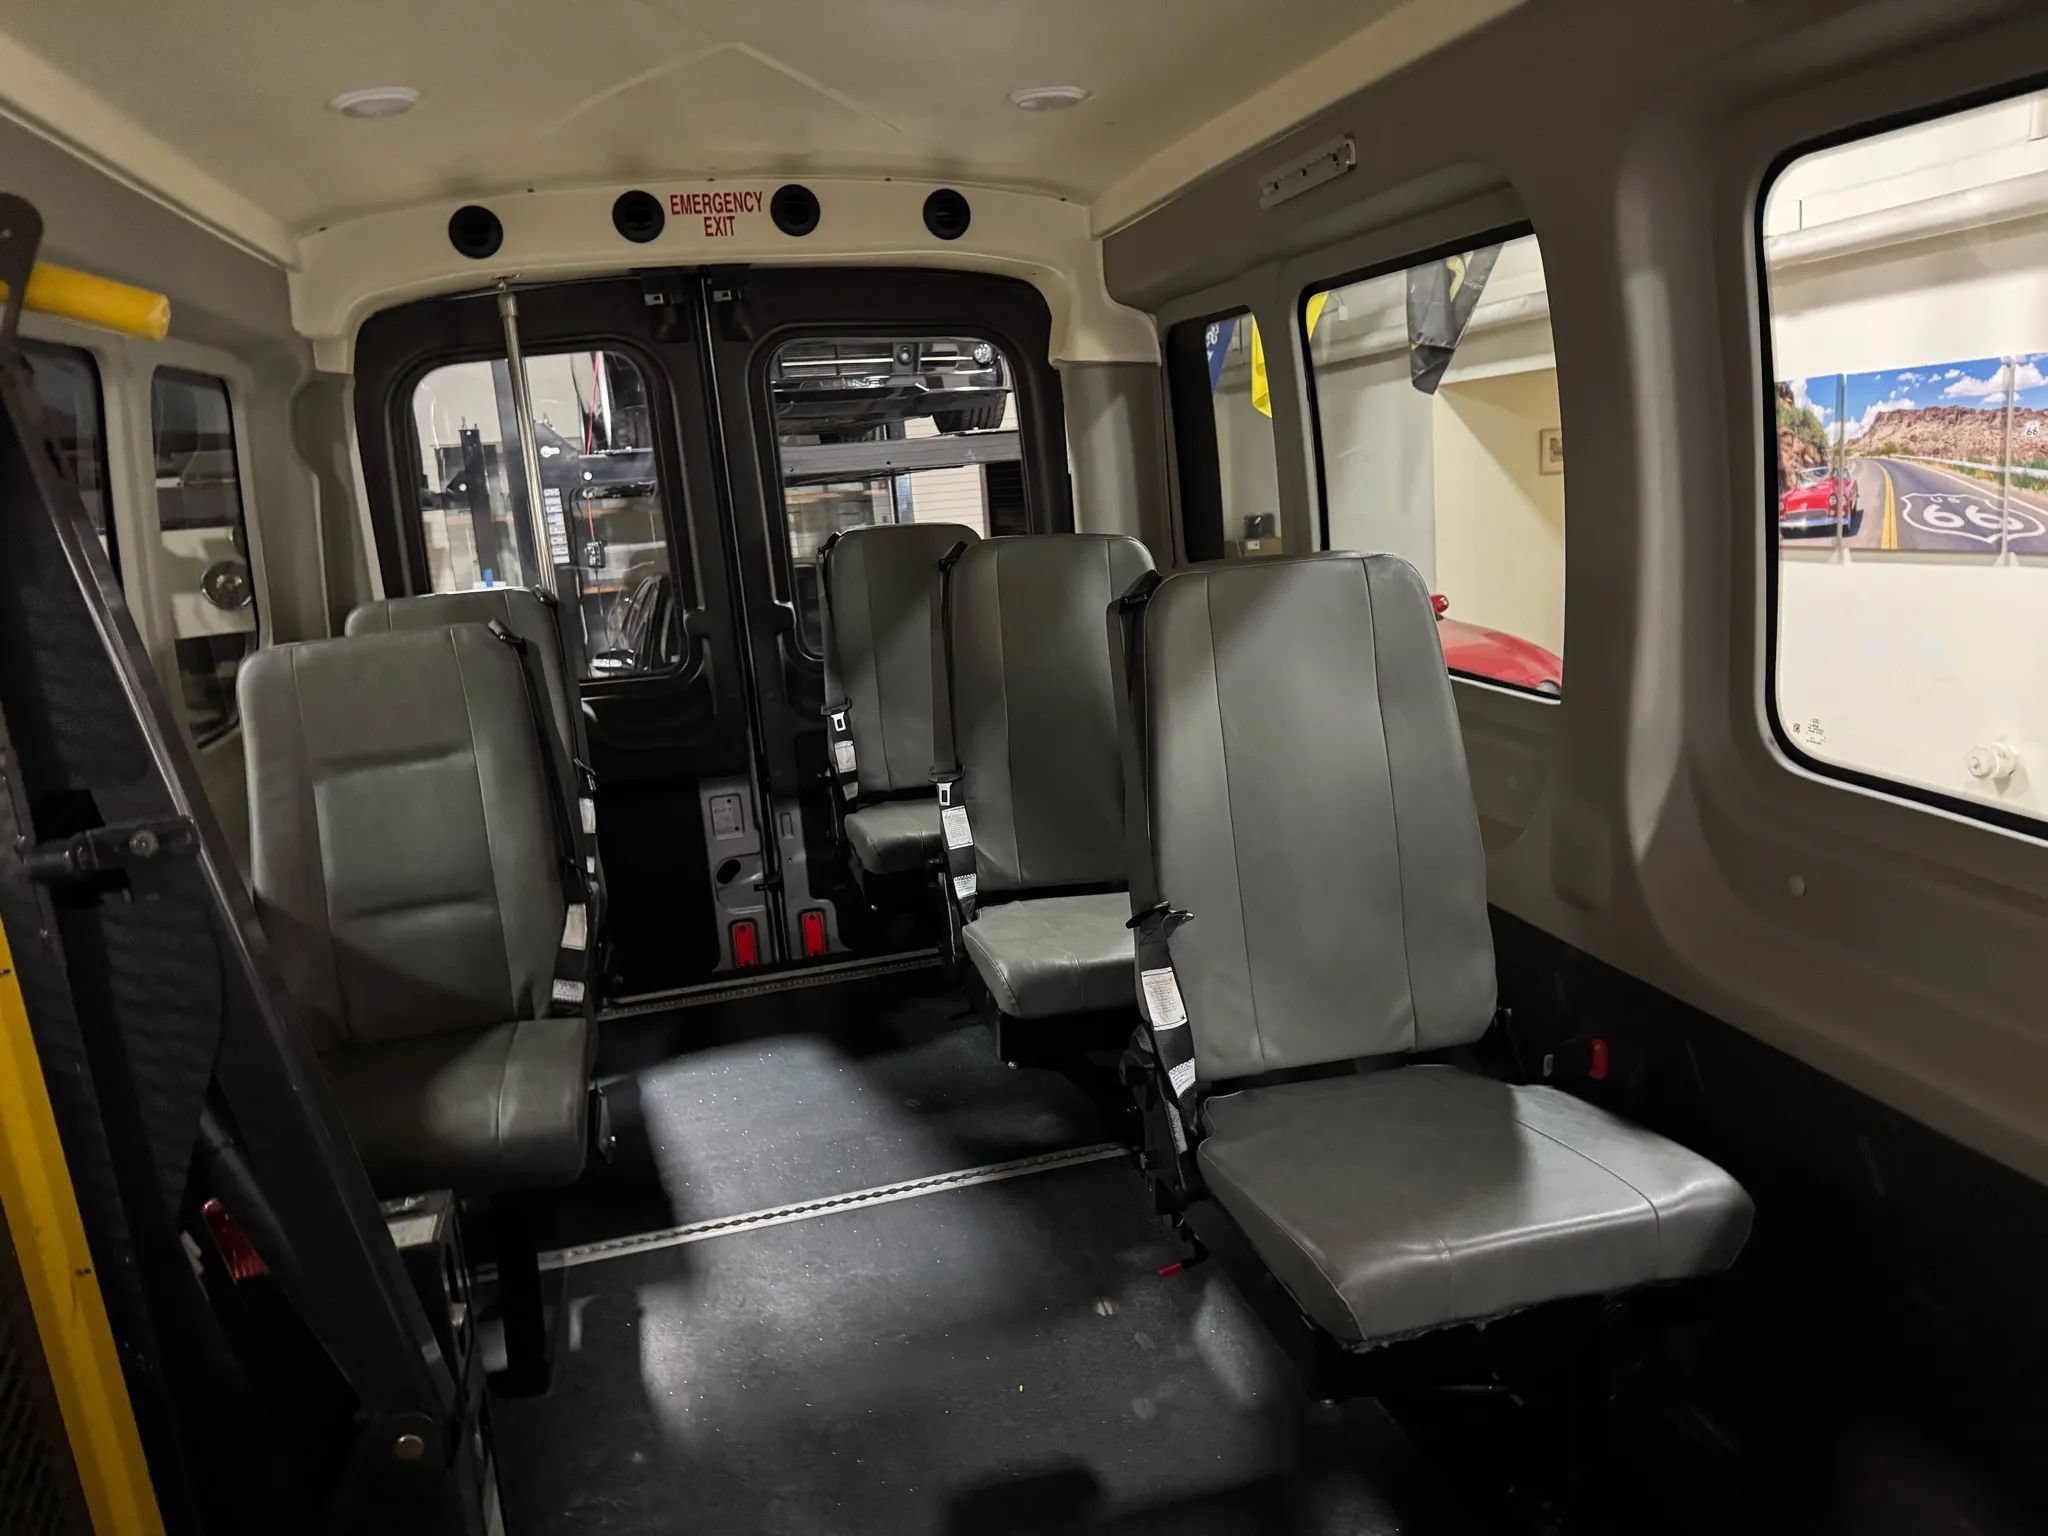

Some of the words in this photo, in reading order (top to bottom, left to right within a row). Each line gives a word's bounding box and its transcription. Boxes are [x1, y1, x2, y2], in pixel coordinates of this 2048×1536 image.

[670, 191, 763, 215] EMERGENCY
[703, 215, 735, 237] EXIT
[1923, 503, 2025, 531] 66
